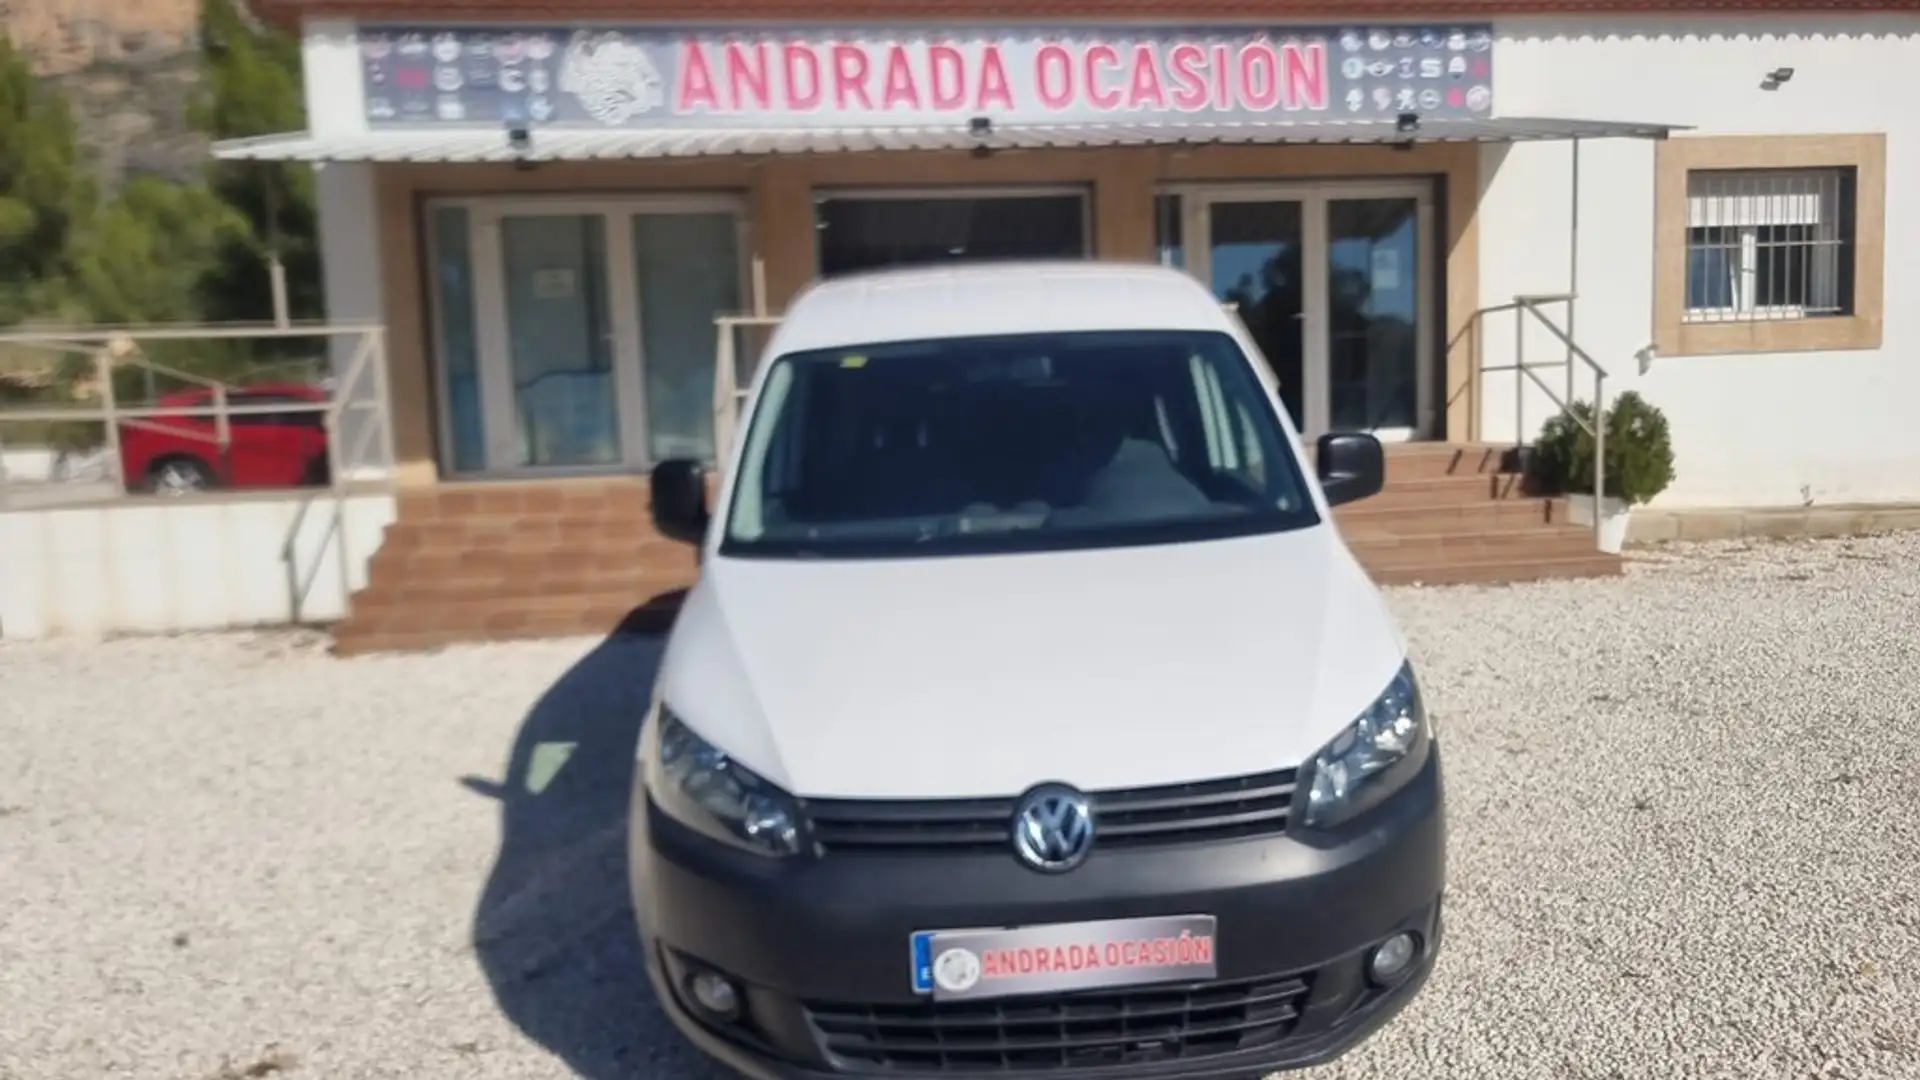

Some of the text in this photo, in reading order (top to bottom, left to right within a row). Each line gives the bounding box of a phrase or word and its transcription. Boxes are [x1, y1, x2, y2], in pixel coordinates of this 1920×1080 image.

[676, 33, 1327, 112] ANDRADA OCASIÓN
[982, 929, 1213, 977] ANDRADA OCASIÓN
